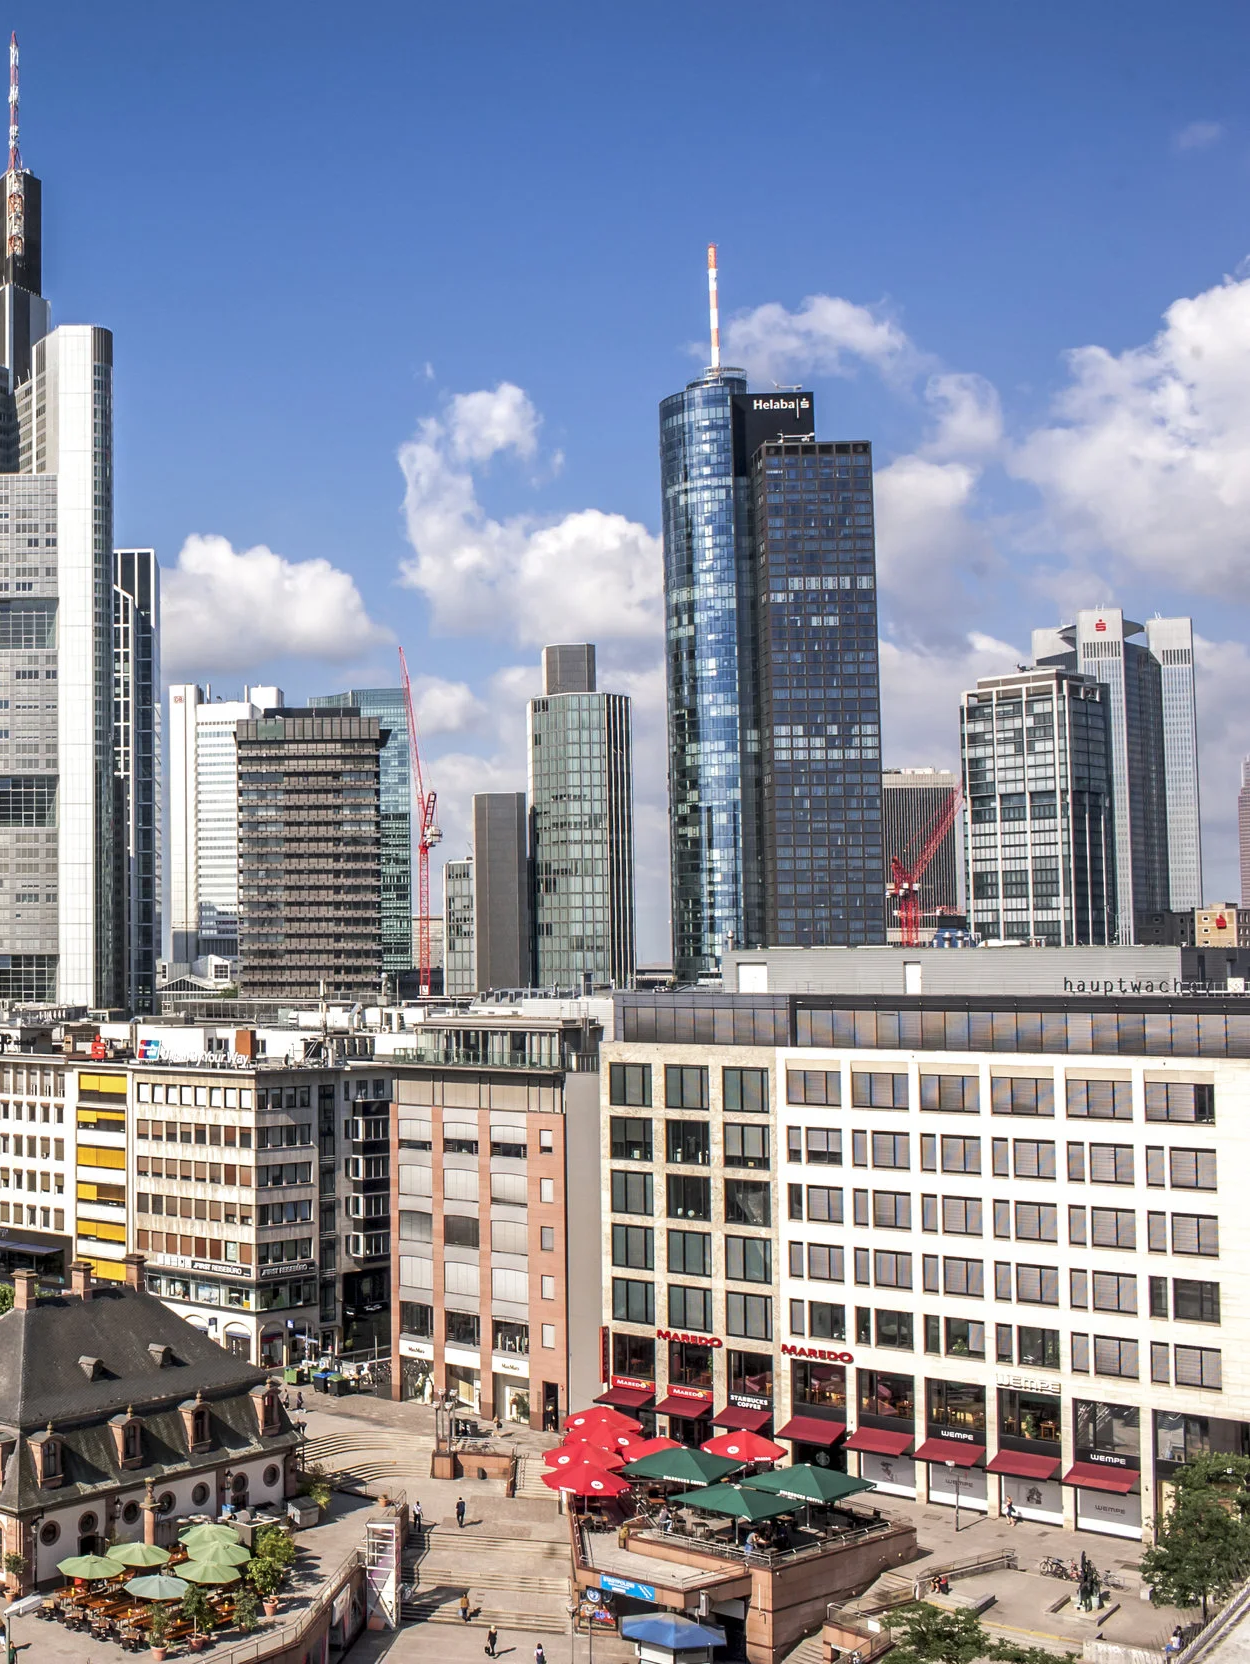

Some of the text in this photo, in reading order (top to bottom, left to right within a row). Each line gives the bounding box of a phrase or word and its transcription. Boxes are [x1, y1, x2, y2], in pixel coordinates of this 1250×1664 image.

[753, 398, 795, 410] Helaba
[227, 1051, 249, 1069] Way
[657, 1329, 723, 1349] MAREDO
[781, 1343, 855, 1364] MAREDO
[616, 1379, 647, 1389] MAREDO
[996, 1373, 1061, 1394] WEMPE
[673, 1388, 704, 1399] MAREDO
[730, 1394, 769, 1406] STARBUCKS
[737, 1401, 762, 1410] COFFEE
[941, 1429, 974, 1441] WEMPE
[1090, 1453, 1126, 1465] WEMPE
[945, 1478, 974, 1488] WEMPE
[1094, 1504, 1126, 1515] WEMPE
